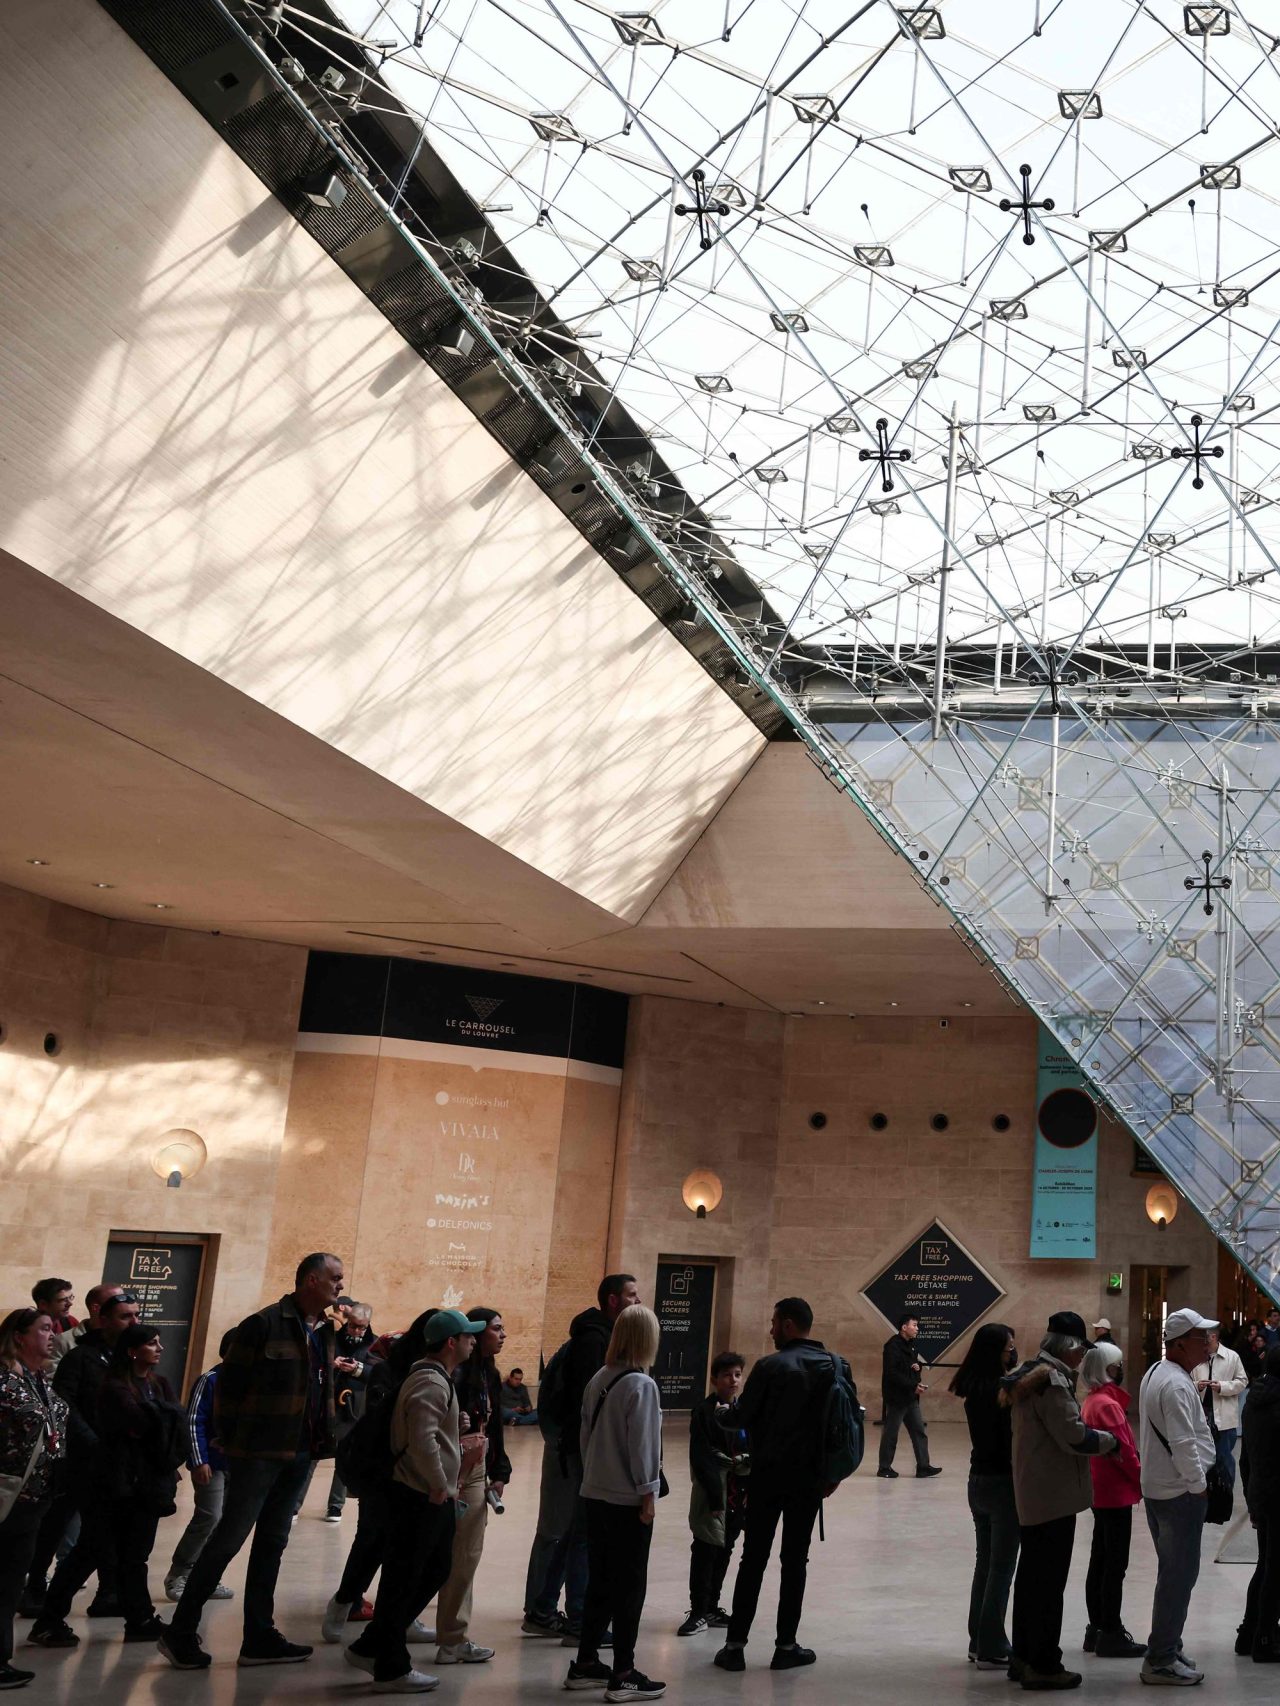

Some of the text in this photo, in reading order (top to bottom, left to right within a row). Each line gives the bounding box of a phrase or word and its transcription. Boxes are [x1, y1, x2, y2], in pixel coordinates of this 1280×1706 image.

[445, 1019, 516, 1035] LE CARROUSEL
[473, 1031, 500, 1039] LOUVRE
[440, 1120, 499, 1140] VIVAIA
[439, 1219, 493, 1231] DELFONICS
[926, 1246, 942, 1254] TAX
[137, 1255, 161, 1265] TAX
[138, 1265, 161, 1273] FREE
[932, 1274, 973, 1282] SHOPPING
[918, 1281, 948, 1289] DÉTAXE
[661, 1306, 690, 1314] LOCKERS
[620, 1681, 638, 1690] HOKA
